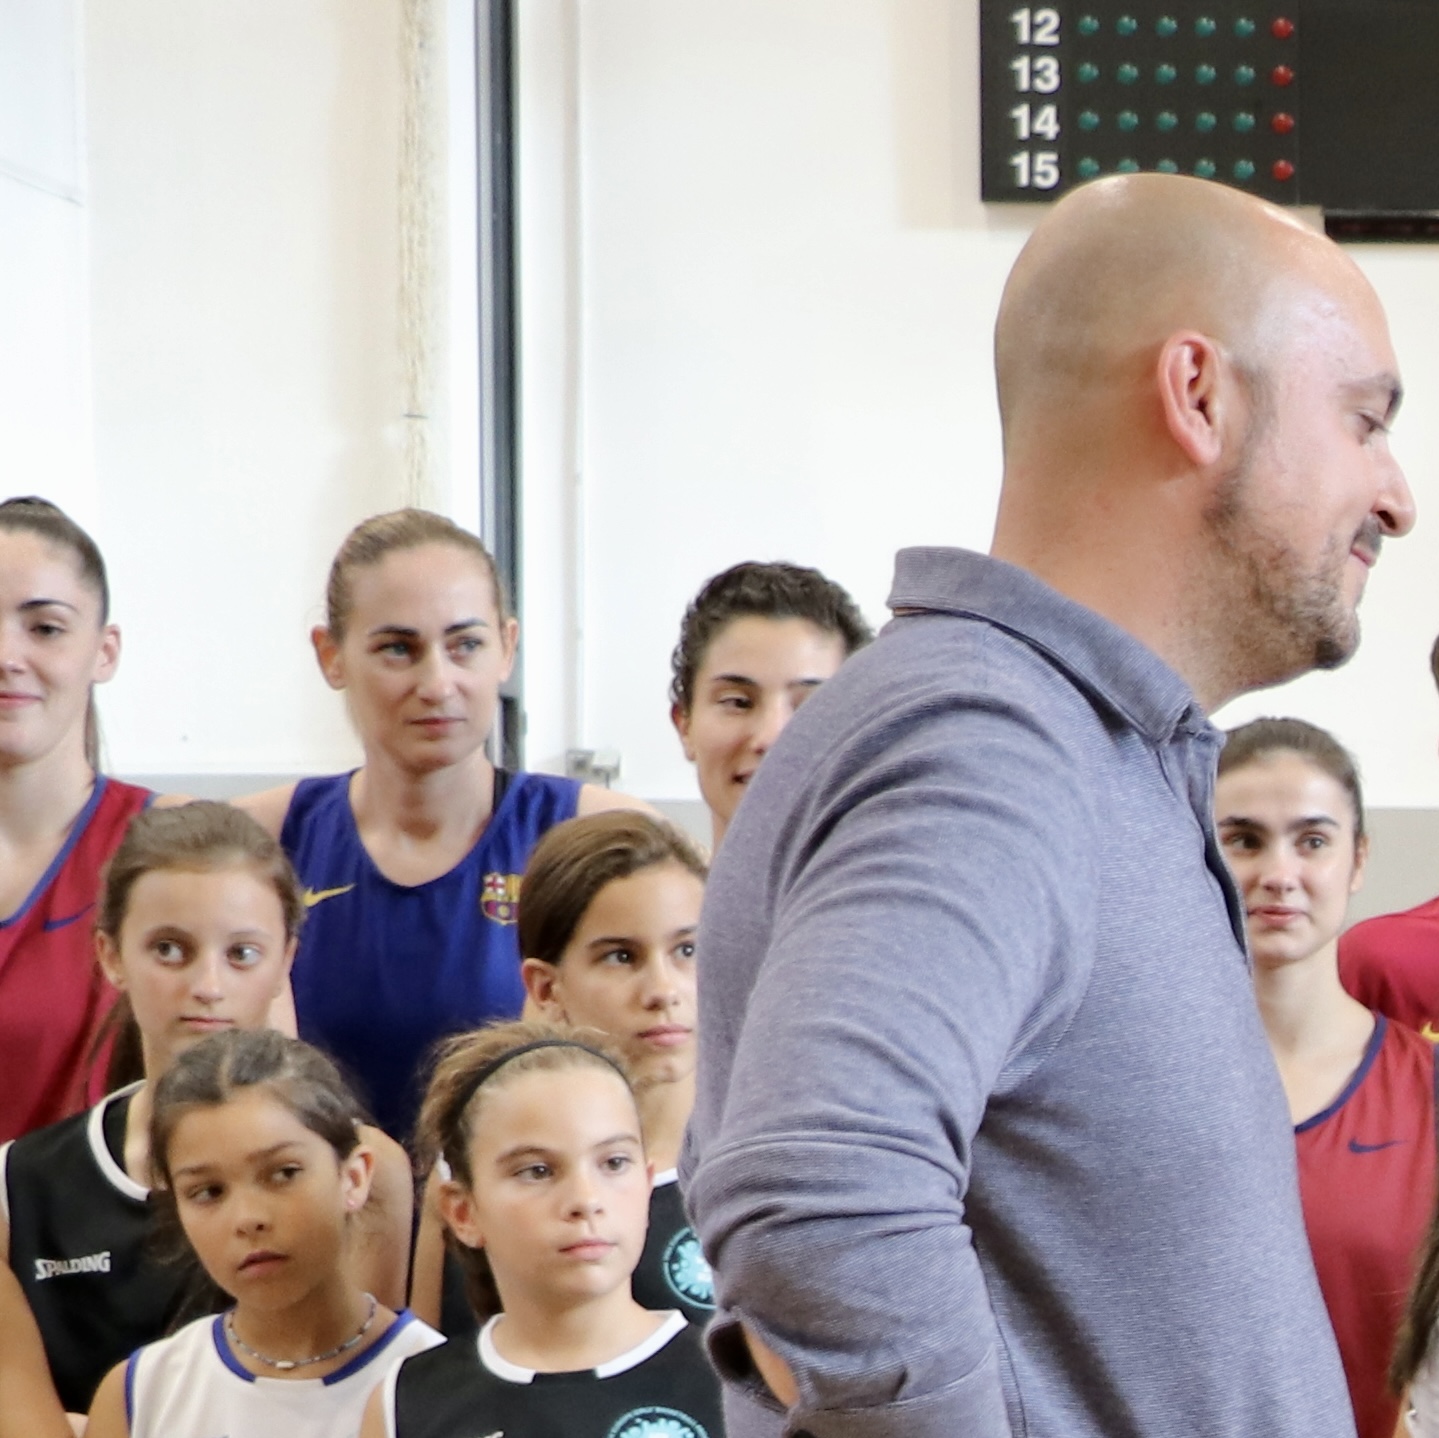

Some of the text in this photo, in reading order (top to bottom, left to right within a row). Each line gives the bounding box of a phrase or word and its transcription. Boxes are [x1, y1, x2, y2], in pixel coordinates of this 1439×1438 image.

[1010, 8, 1060, 45] 12
[1010, 55, 1060, 93] 13
[1010, 103, 1060, 140] 14
[1010, 151, 1060, 189] 15
[35, 1251, 111, 1280] SPALDING
